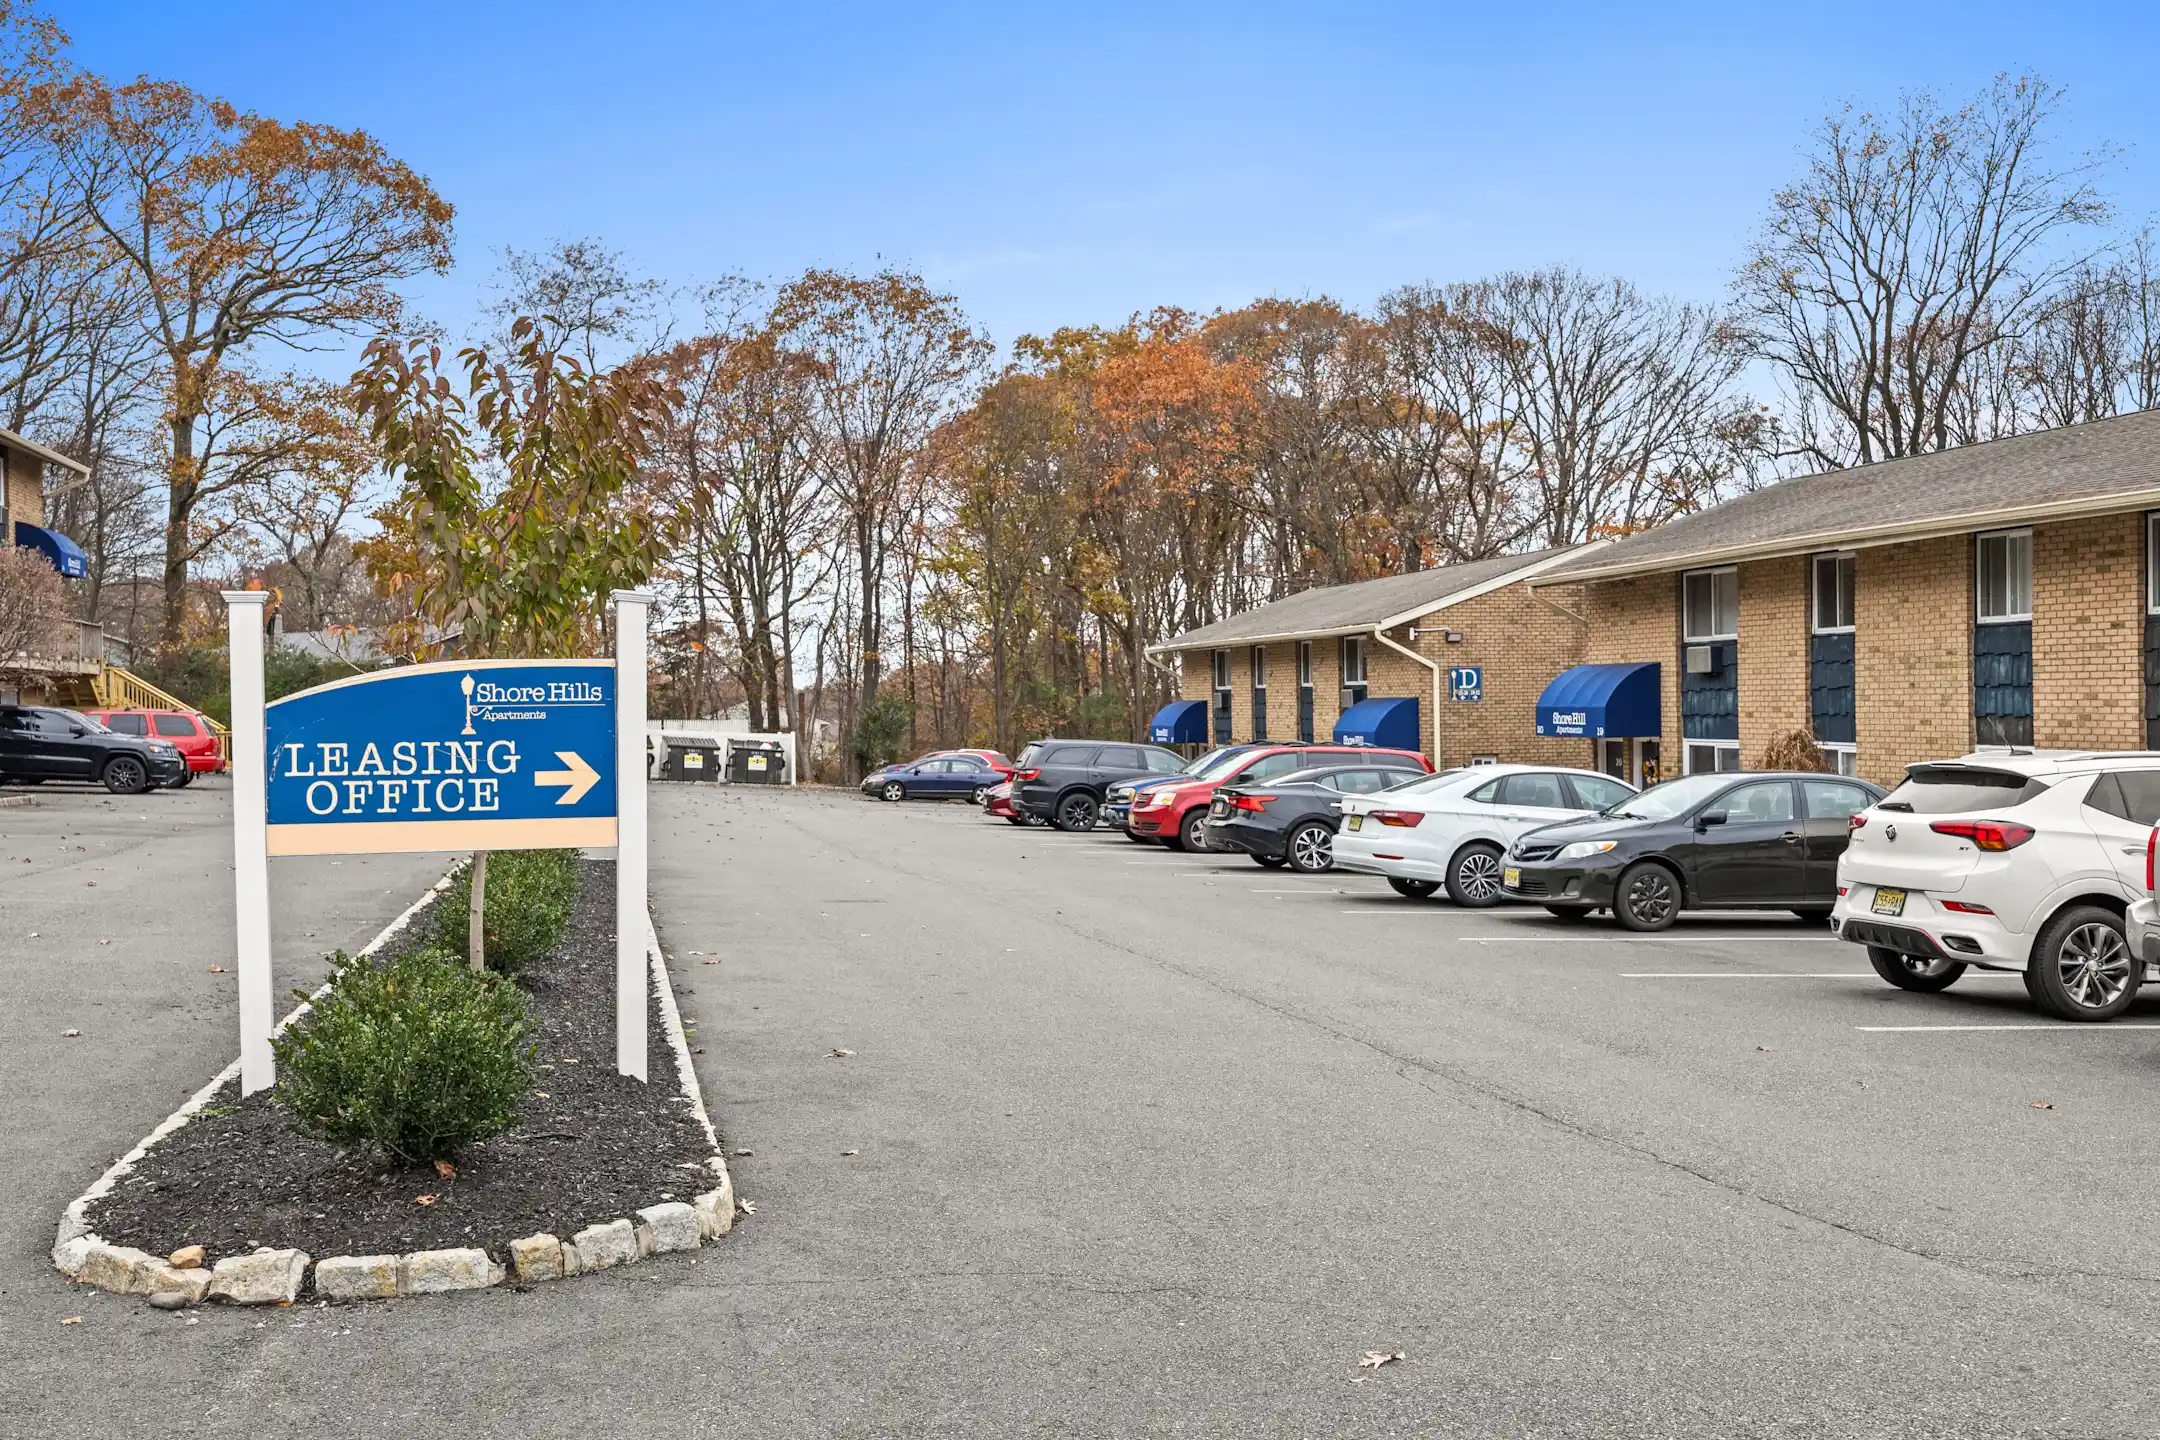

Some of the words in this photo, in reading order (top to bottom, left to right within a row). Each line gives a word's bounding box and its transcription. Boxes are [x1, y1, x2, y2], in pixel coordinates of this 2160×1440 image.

[1459, 669, 1477, 689] D
[477, 683, 545, 702] Shore
[547, 682, 602, 701] Hills
[482, 710, 546, 722] Apartments
[1553, 712, 1572, 725] Shore
[1572, 712, 1586, 725] Hill
[1556, 725, 1583, 734] Apartments
[1596, 726, 1604, 736] 19
[284, 740, 521, 777] LEASING
[306, 778, 499, 815] OFFICE
